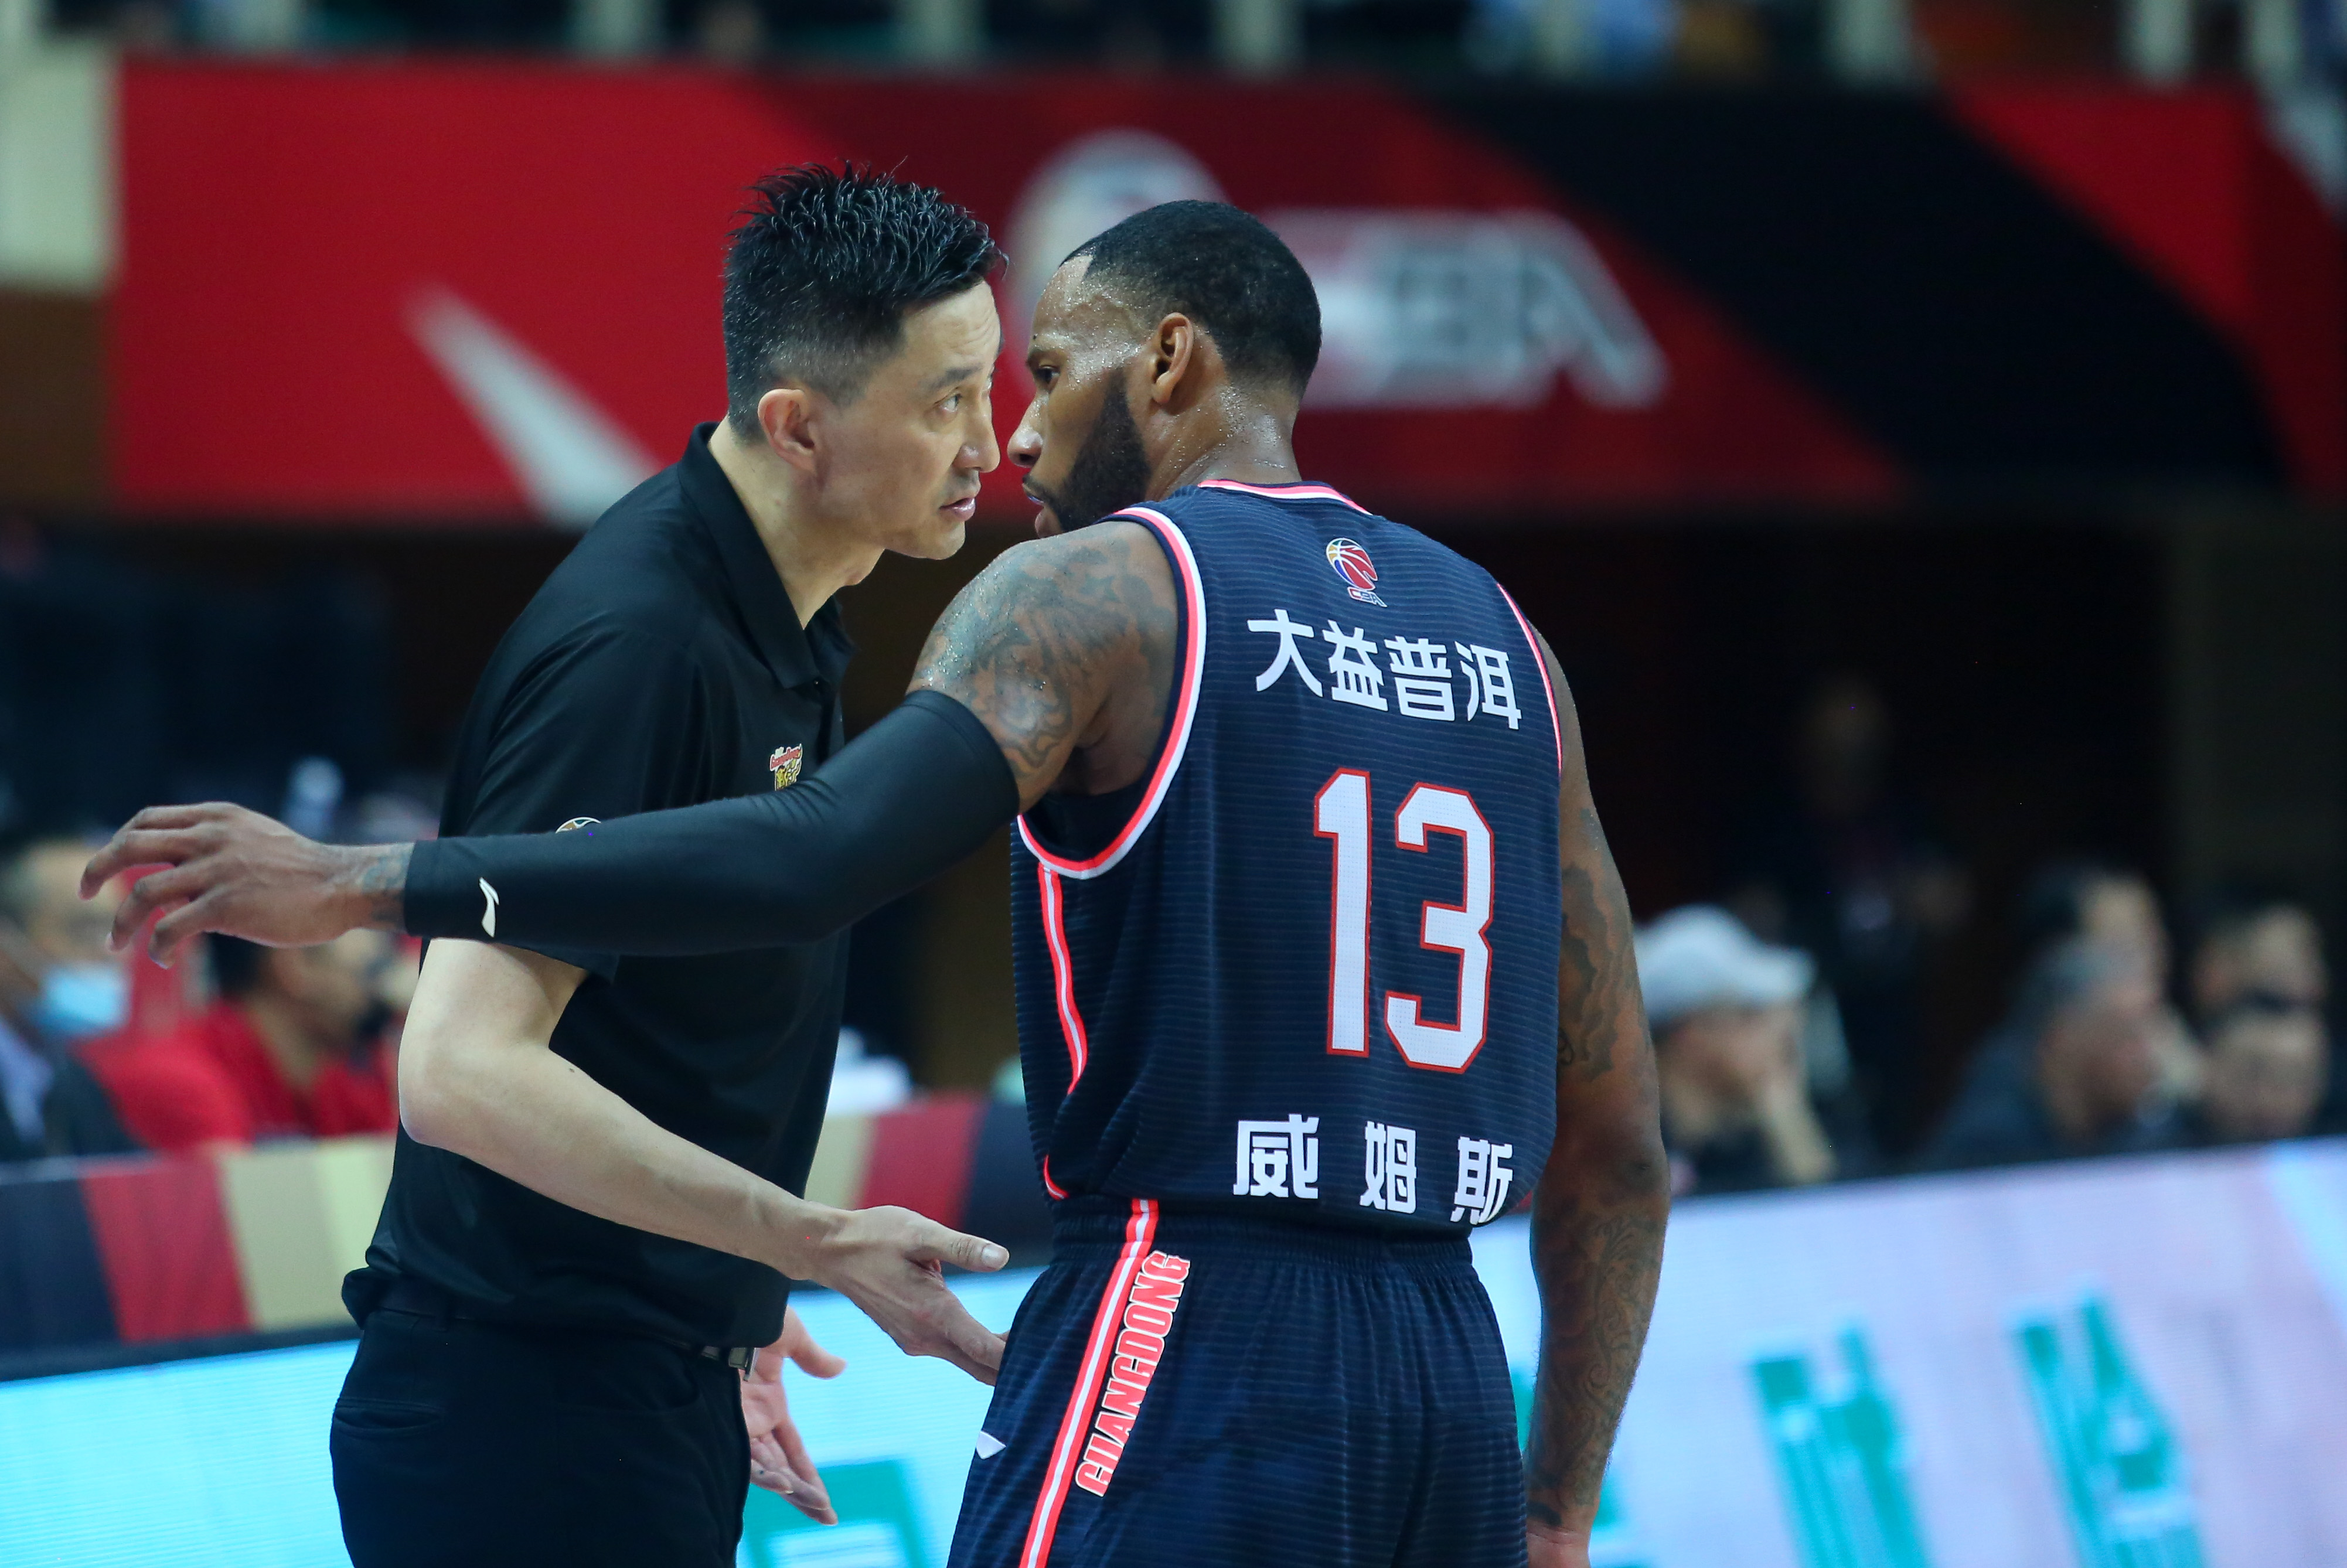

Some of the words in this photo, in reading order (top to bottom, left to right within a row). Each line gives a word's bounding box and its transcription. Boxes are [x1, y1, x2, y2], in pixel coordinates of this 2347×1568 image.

[1347, 587, 1388, 608] CBA
[1247, 608, 1521, 730] 大益普洱
[1314, 768, 1494, 1074] 13
[1233, 1113, 1513, 1225] 威姆斯
[1075, 1250, 1190, 1497] GUANGDONG
